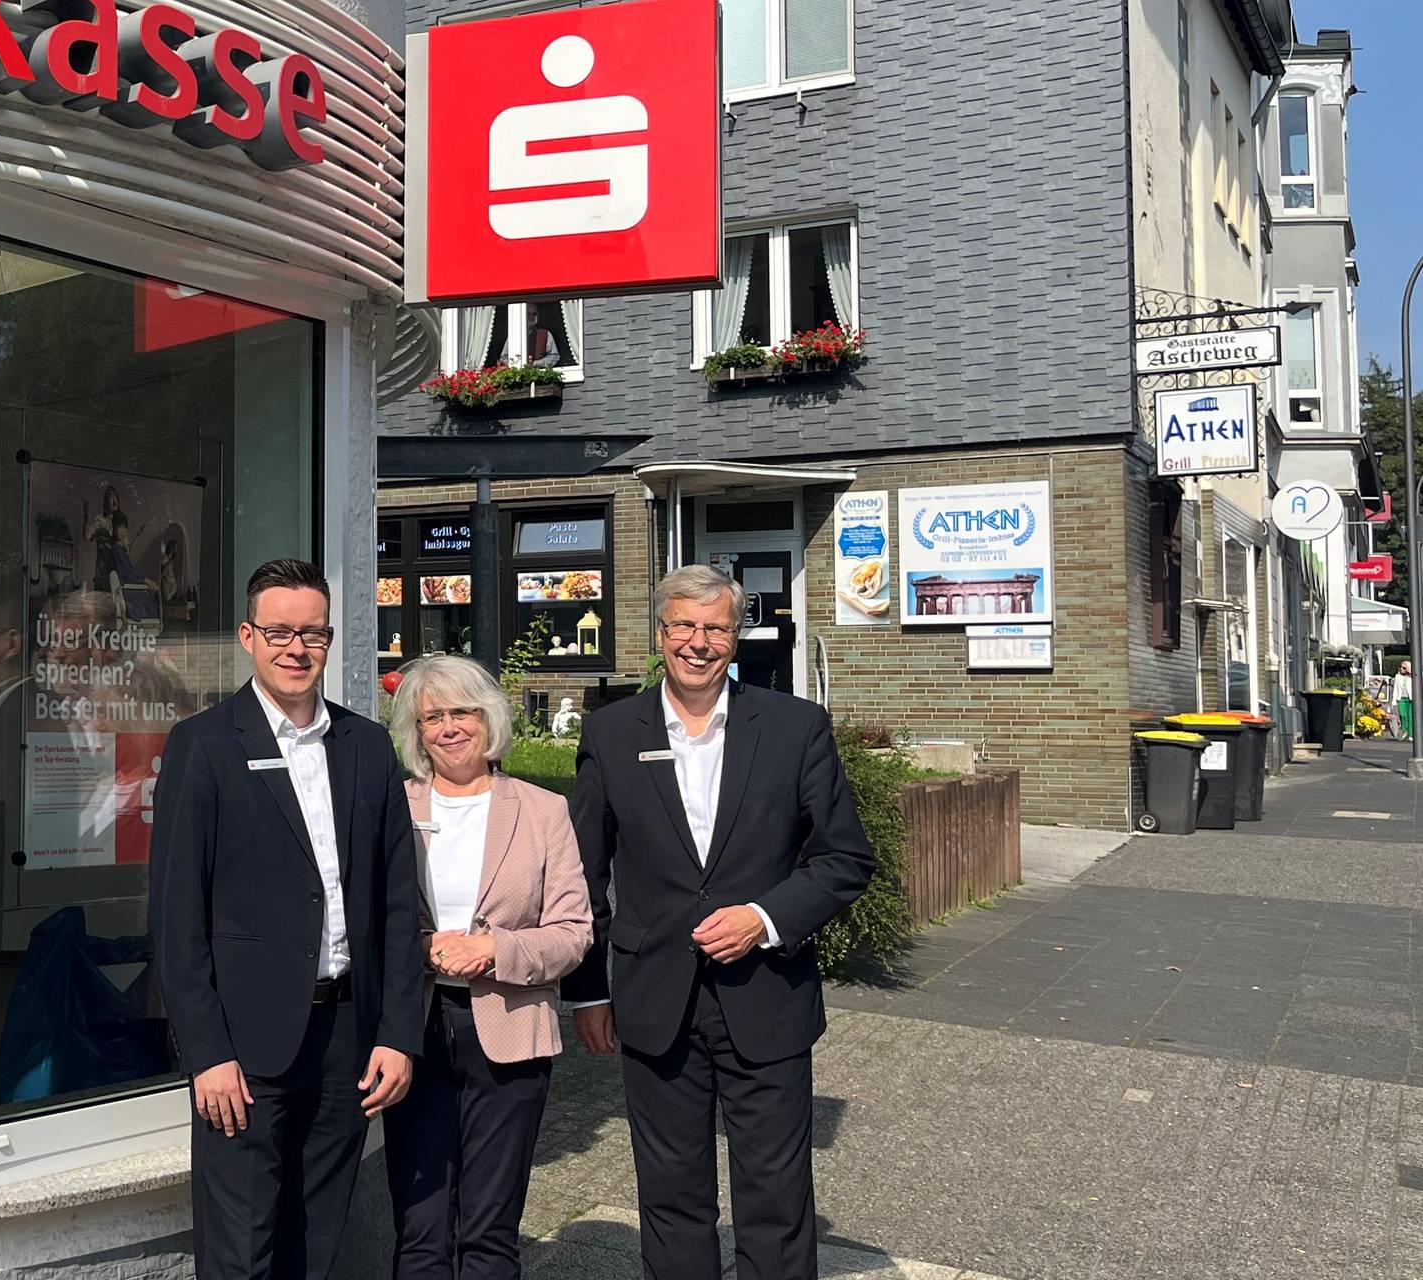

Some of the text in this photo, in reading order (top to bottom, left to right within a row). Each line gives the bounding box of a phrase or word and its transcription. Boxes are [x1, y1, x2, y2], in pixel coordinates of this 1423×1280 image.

[1167, 335, 1237, 348] Gaststätte
[1147, 346, 1258, 367] Ascheweg
[1164, 414, 1244, 443] ATHEN
[1164, 455, 1247, 470] Grill Pizzeria
[431, 526, 453, 537] Grill
[928, 509, 1019, 532] ATHEN
[36, 613, 157, 652] Über Kredite
[35, 657, 134, 690] sprechen?
[35, 692, 181, 721] Besser mit uns.
